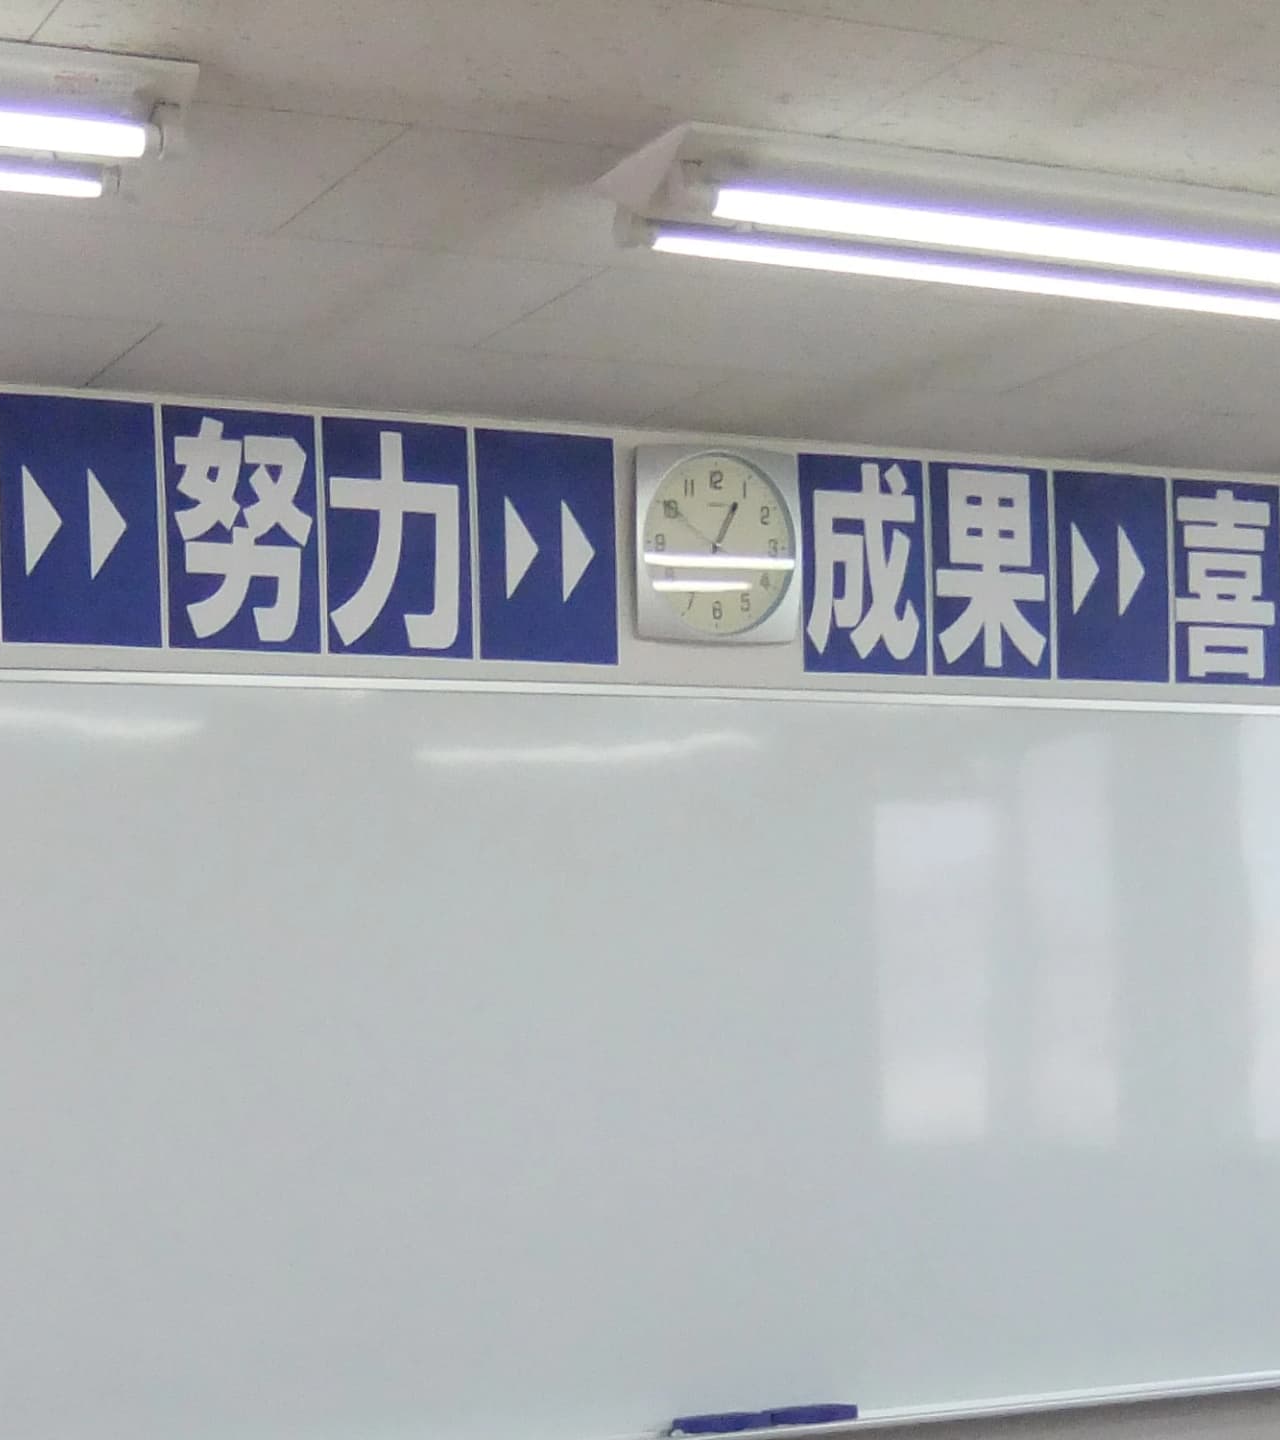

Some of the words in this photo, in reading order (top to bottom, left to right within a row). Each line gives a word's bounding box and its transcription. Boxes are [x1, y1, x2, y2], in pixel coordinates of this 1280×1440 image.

[684, 479, 695, 497] 11
[708, 470, 724, 490] 12
[760, 506, 770, 525] 2
[173, 417, 460, 650] 努力
[806, 463, 1047, 668] 成果
[712, 601, 723, 620] 6
[740, 593, 751, 612] 5
